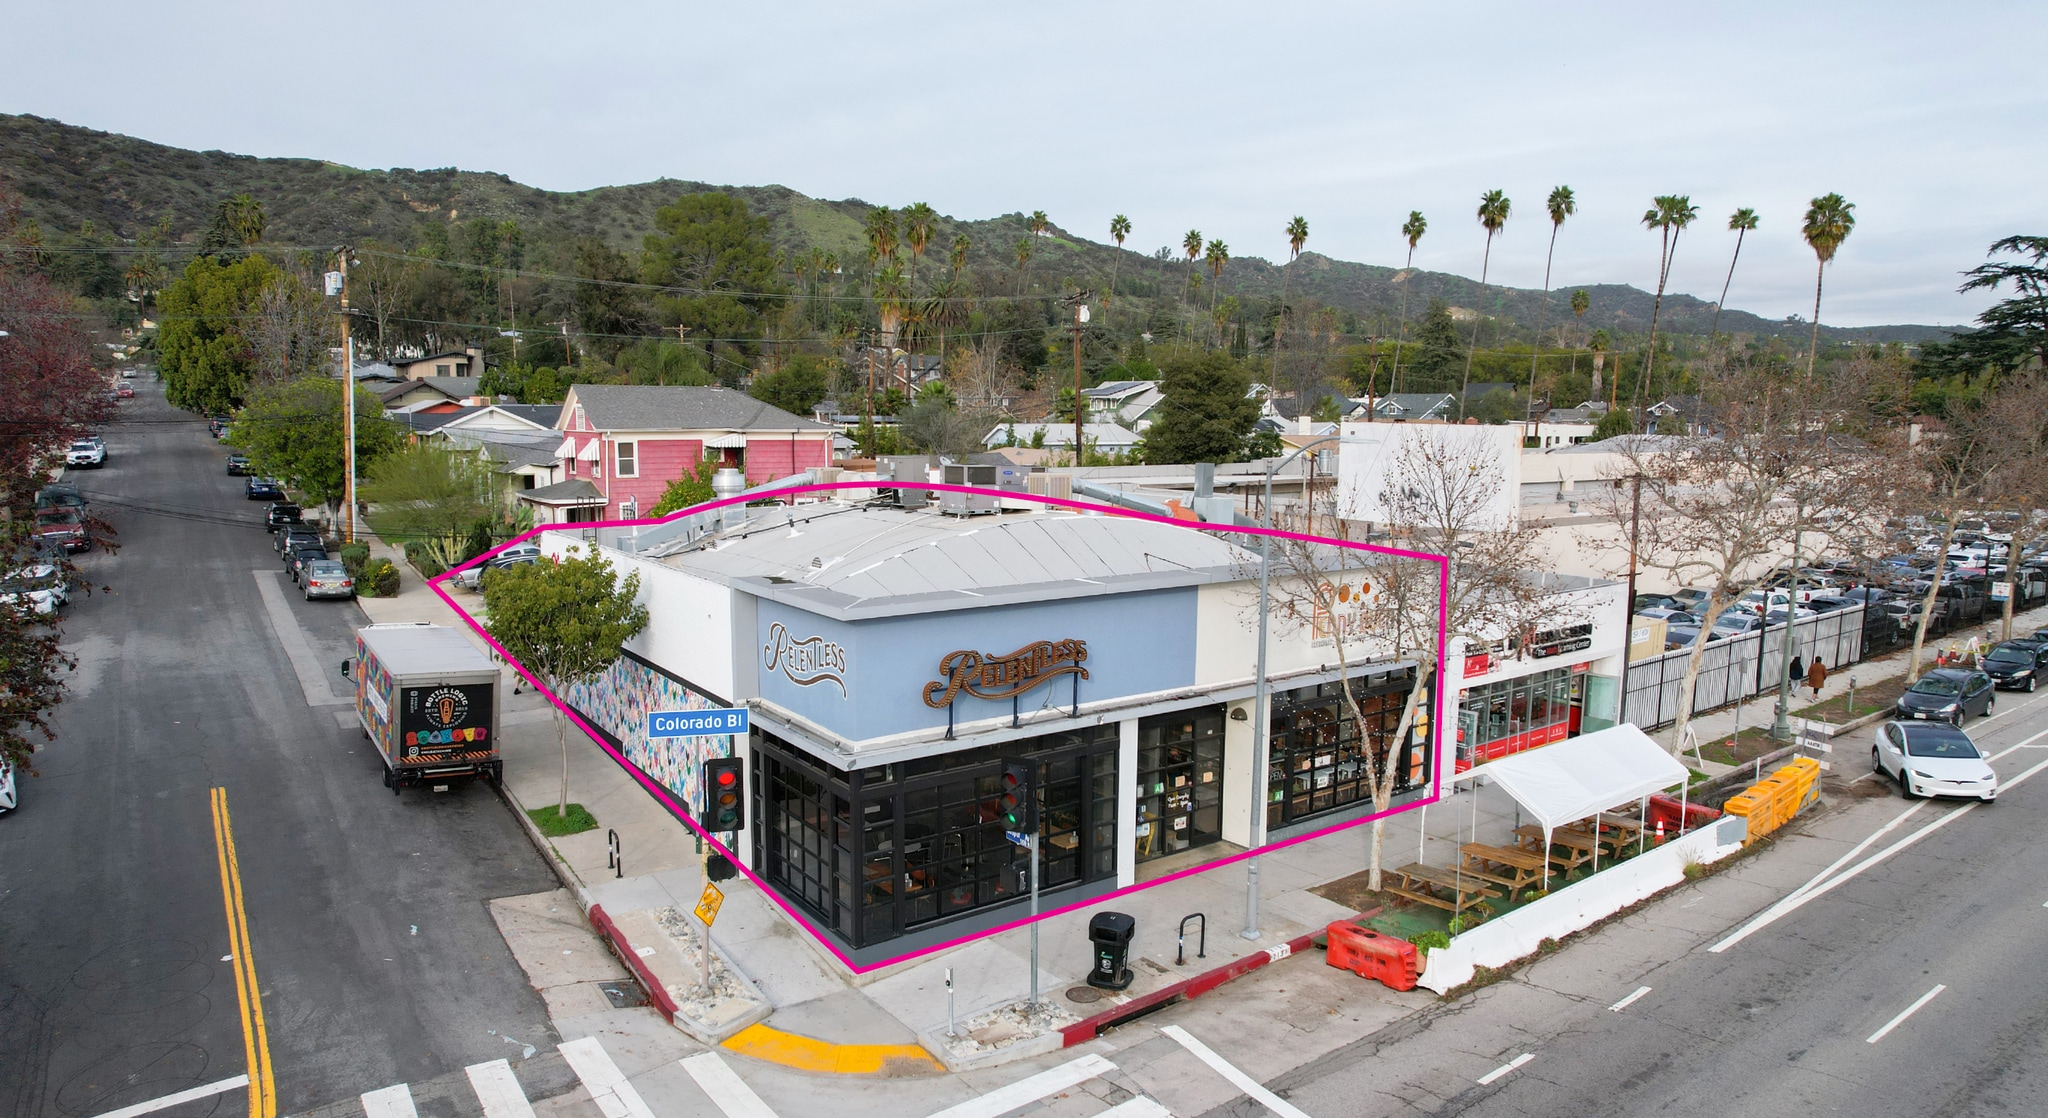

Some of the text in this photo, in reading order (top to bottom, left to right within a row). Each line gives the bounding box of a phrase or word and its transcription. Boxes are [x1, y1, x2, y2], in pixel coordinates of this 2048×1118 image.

[763, 620, 847, 700] RELENTLESS
[922, 637, 1089, 709] RELENTLESS
[425, 688, 468, 707] BOTTLE LOGIC
[655, 714, 742, 731] Colorado Bl
